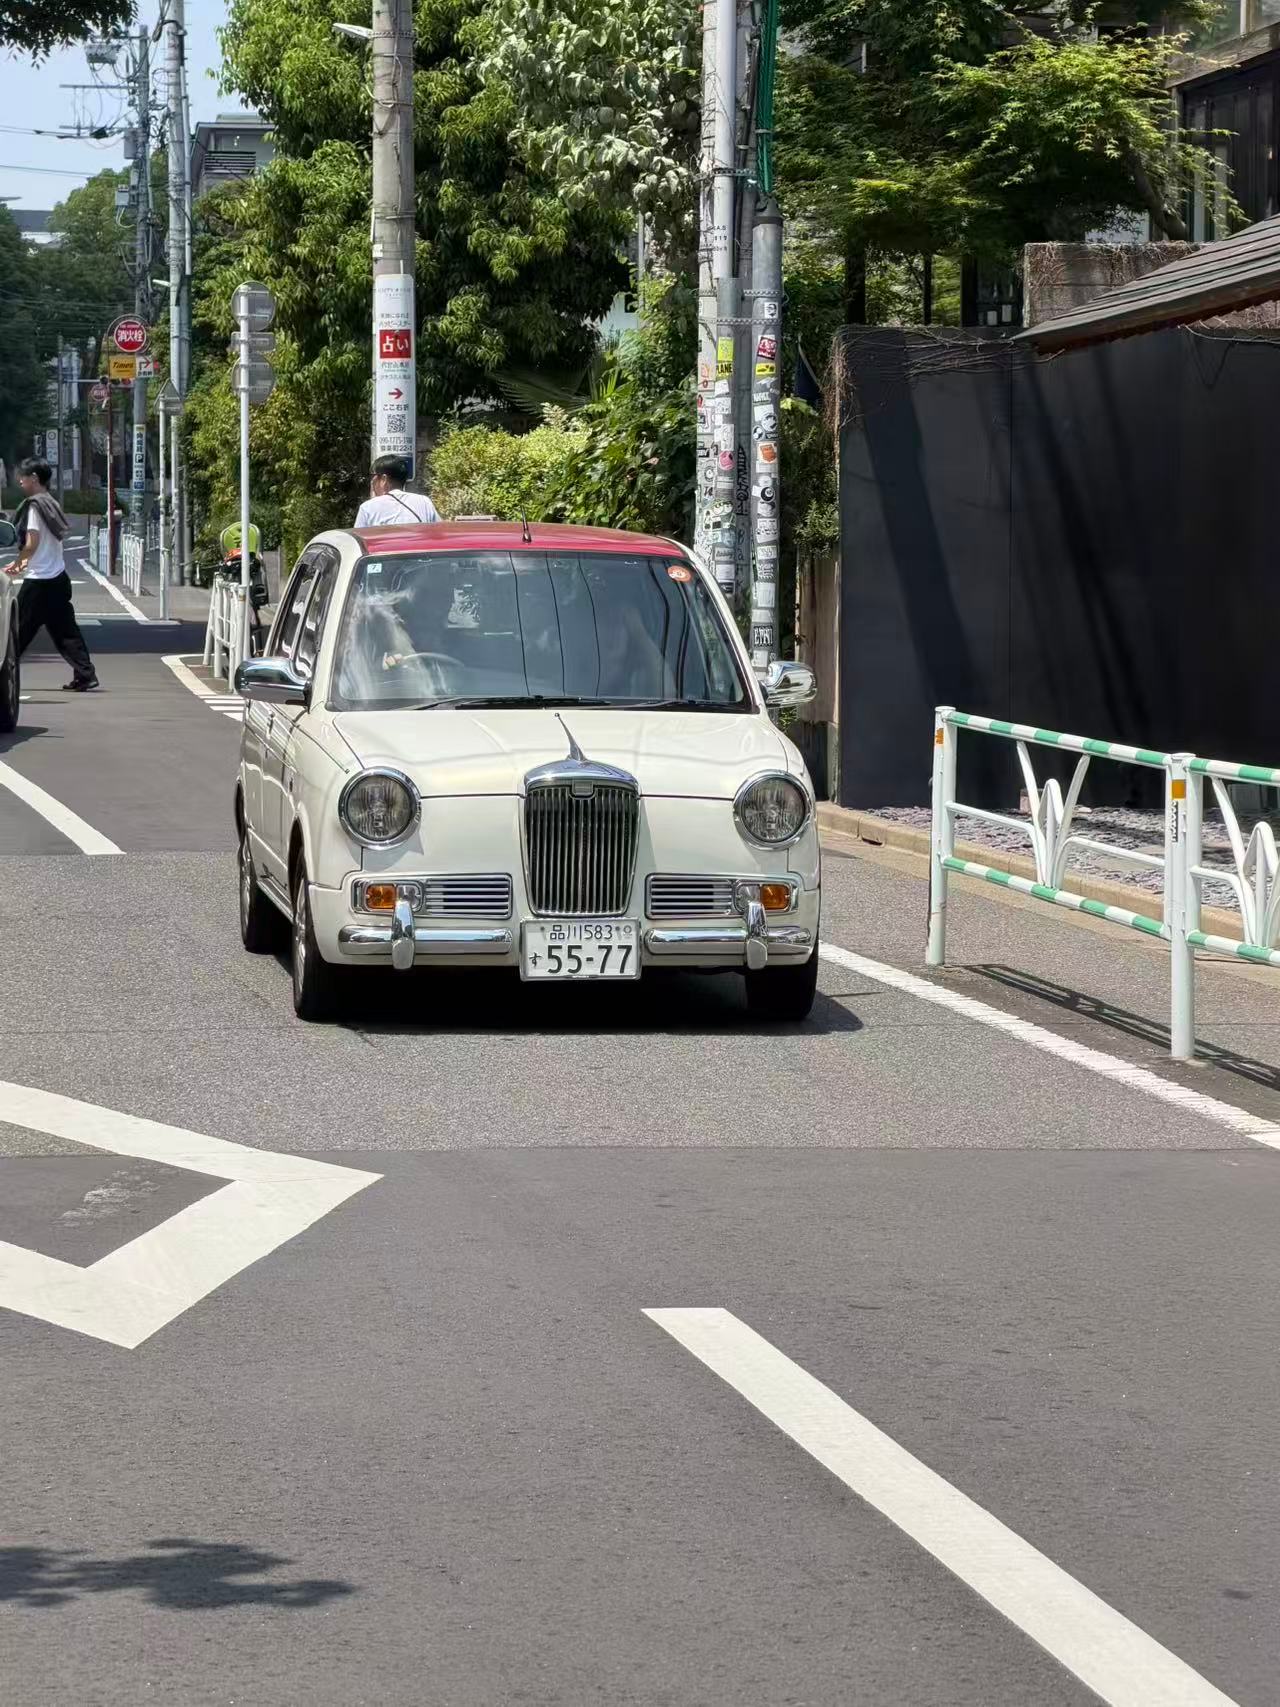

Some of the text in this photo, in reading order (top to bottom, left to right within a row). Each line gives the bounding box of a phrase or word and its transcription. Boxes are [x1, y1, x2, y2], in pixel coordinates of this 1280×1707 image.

[117, 330, 143, 342] 消火栓
[382, 335, 409, 353] 占い
[529, 944, 633, 974] す 55-77
